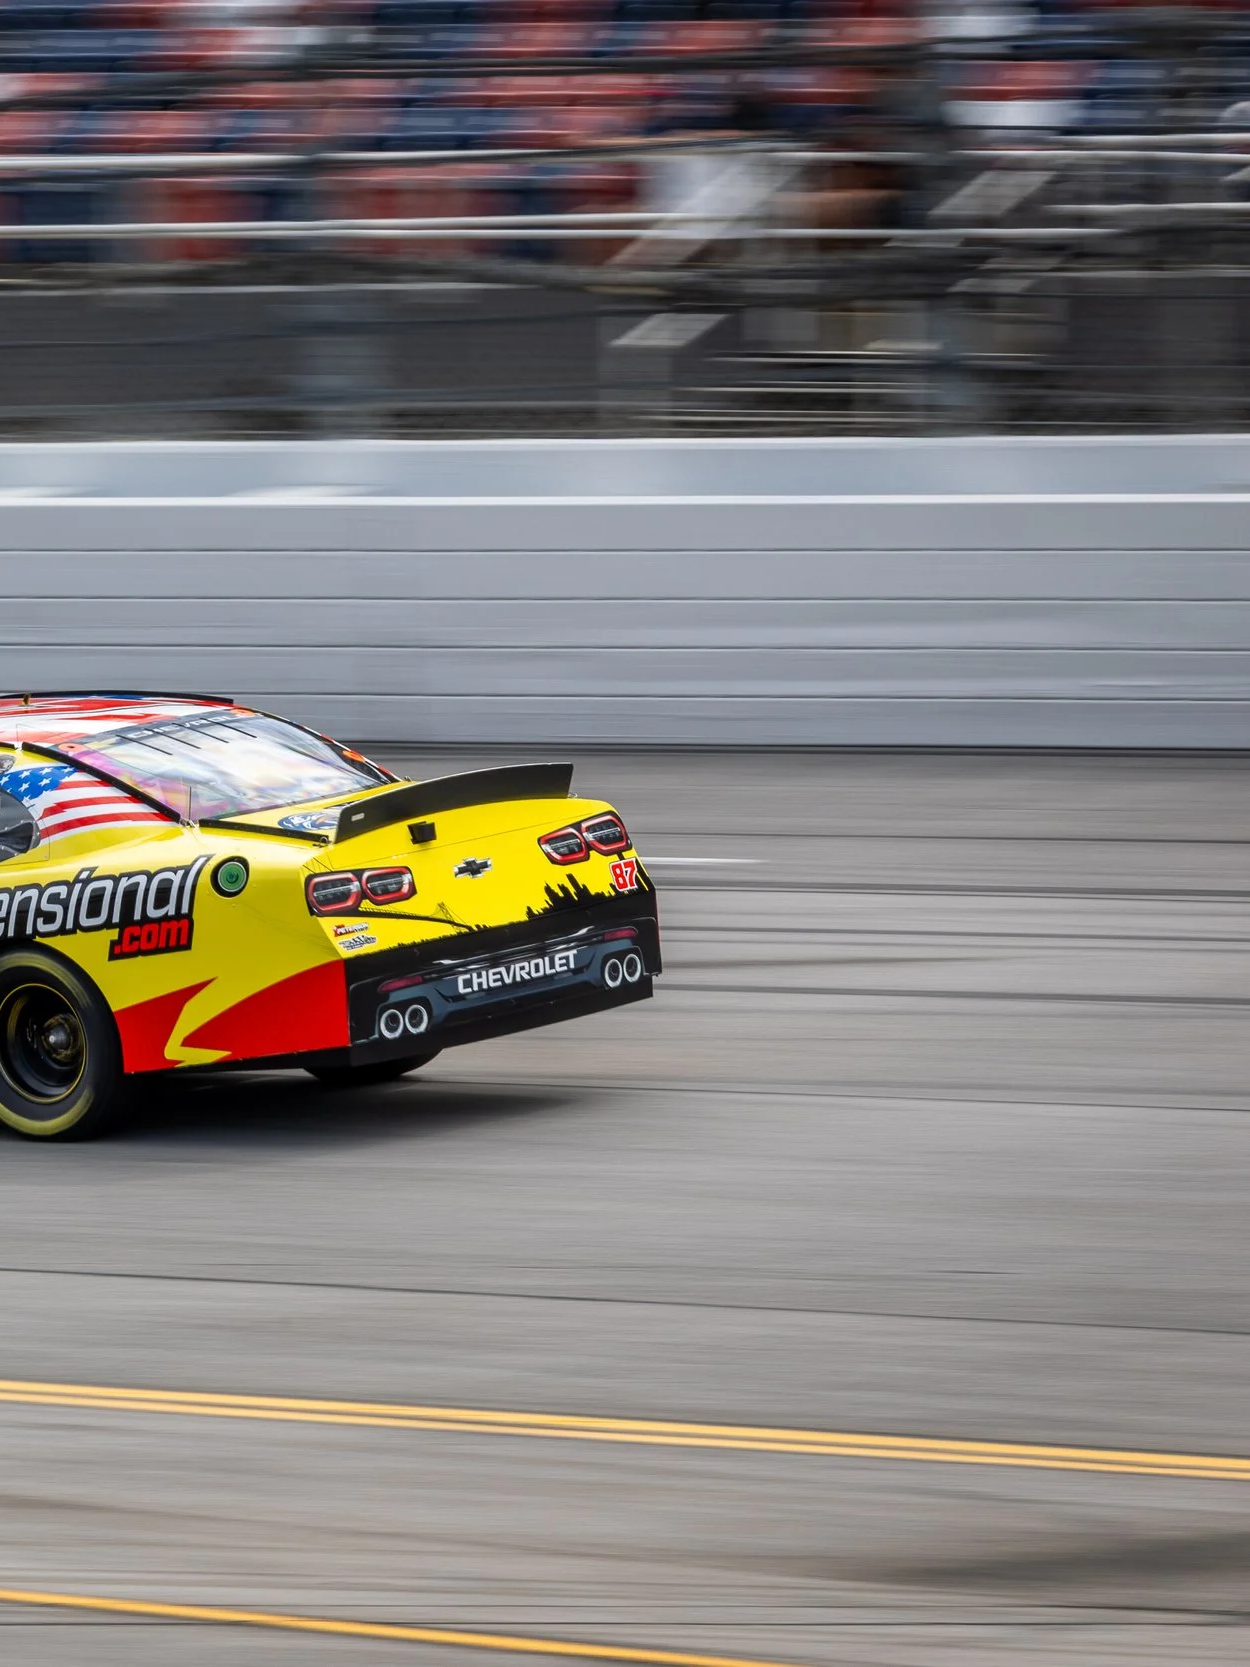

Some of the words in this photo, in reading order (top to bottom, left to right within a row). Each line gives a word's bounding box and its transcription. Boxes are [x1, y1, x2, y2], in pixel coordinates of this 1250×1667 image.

[610, 858, 638, 891] 87
[114, 919, 189, 955] .com
[457, 949, 578, 994] CHEVROLET
